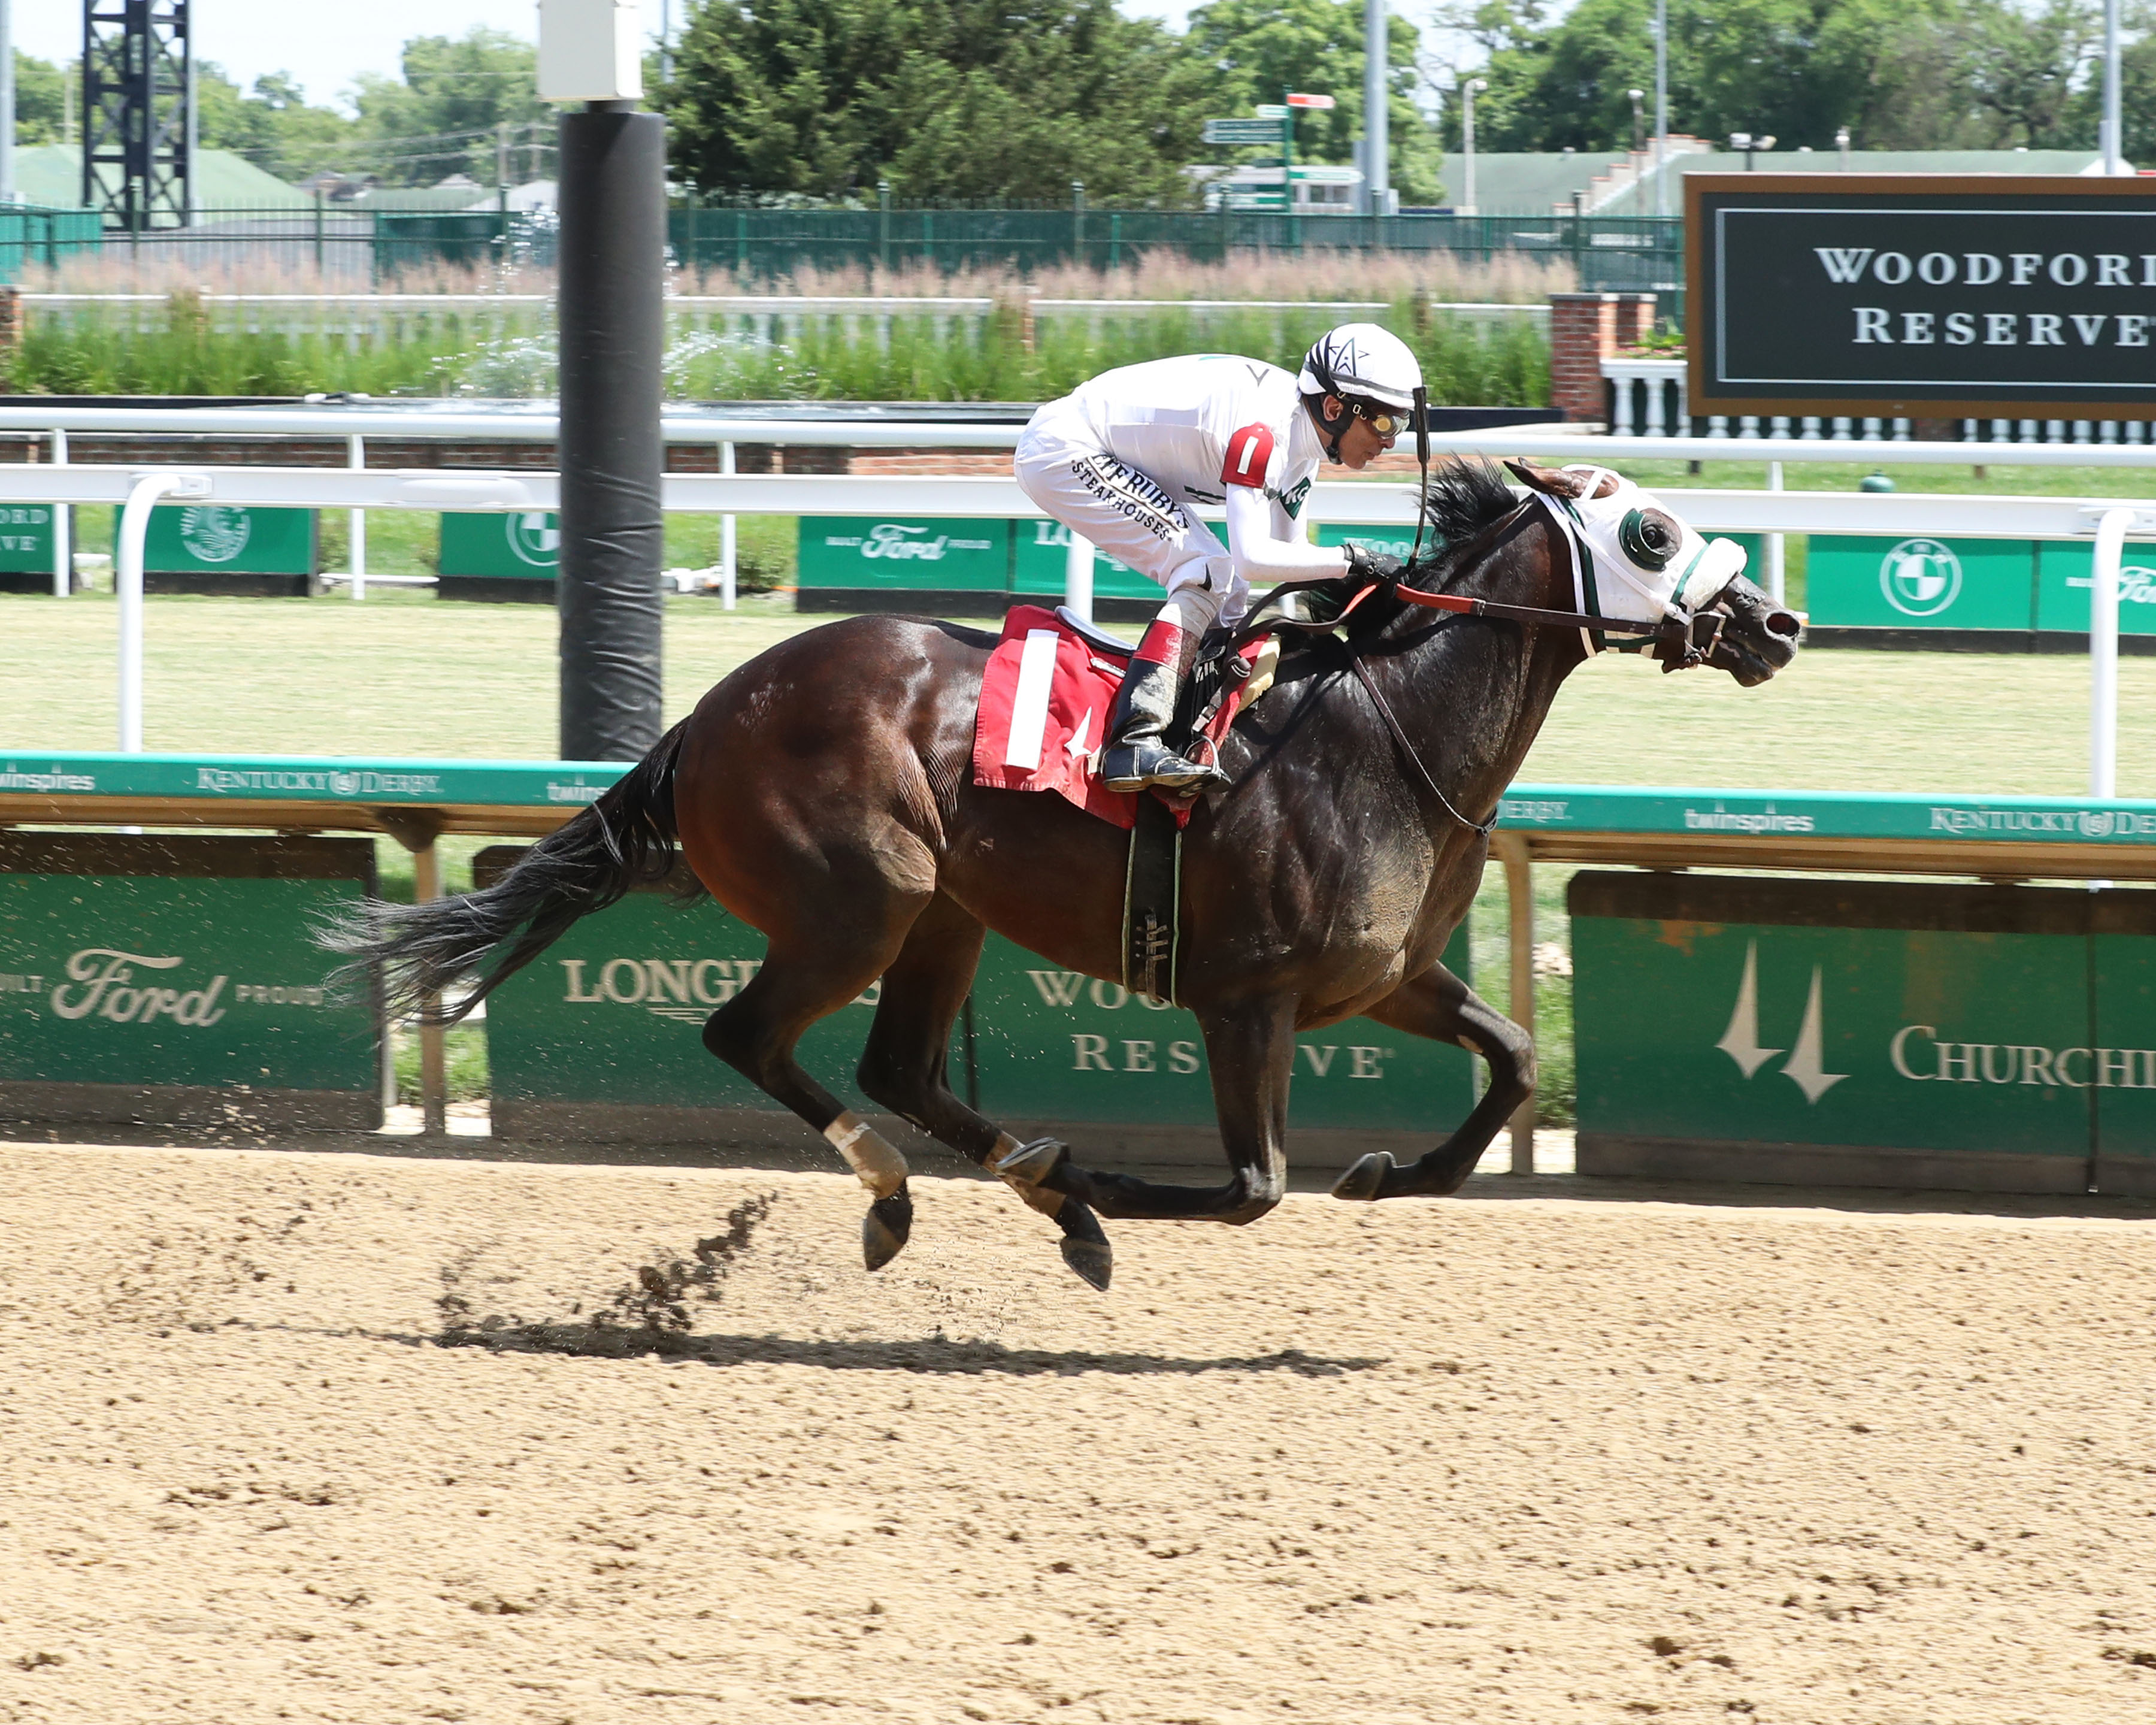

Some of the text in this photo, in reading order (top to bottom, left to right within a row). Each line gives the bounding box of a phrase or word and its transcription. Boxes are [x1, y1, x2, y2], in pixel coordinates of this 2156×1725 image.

[1852, 307, 2149, 347] RESERVE
[1071, 462, 1170, 541] STEAKHOUSES
[861, 523, 948, 560] Ford
[196, 768, 331, 792] KENTUCKY
[1684, 800, 1815, 835] twinspires
[1929, 807, 2078, 834] KENTUCKY
[50, 948, 229, 1027] Ford
